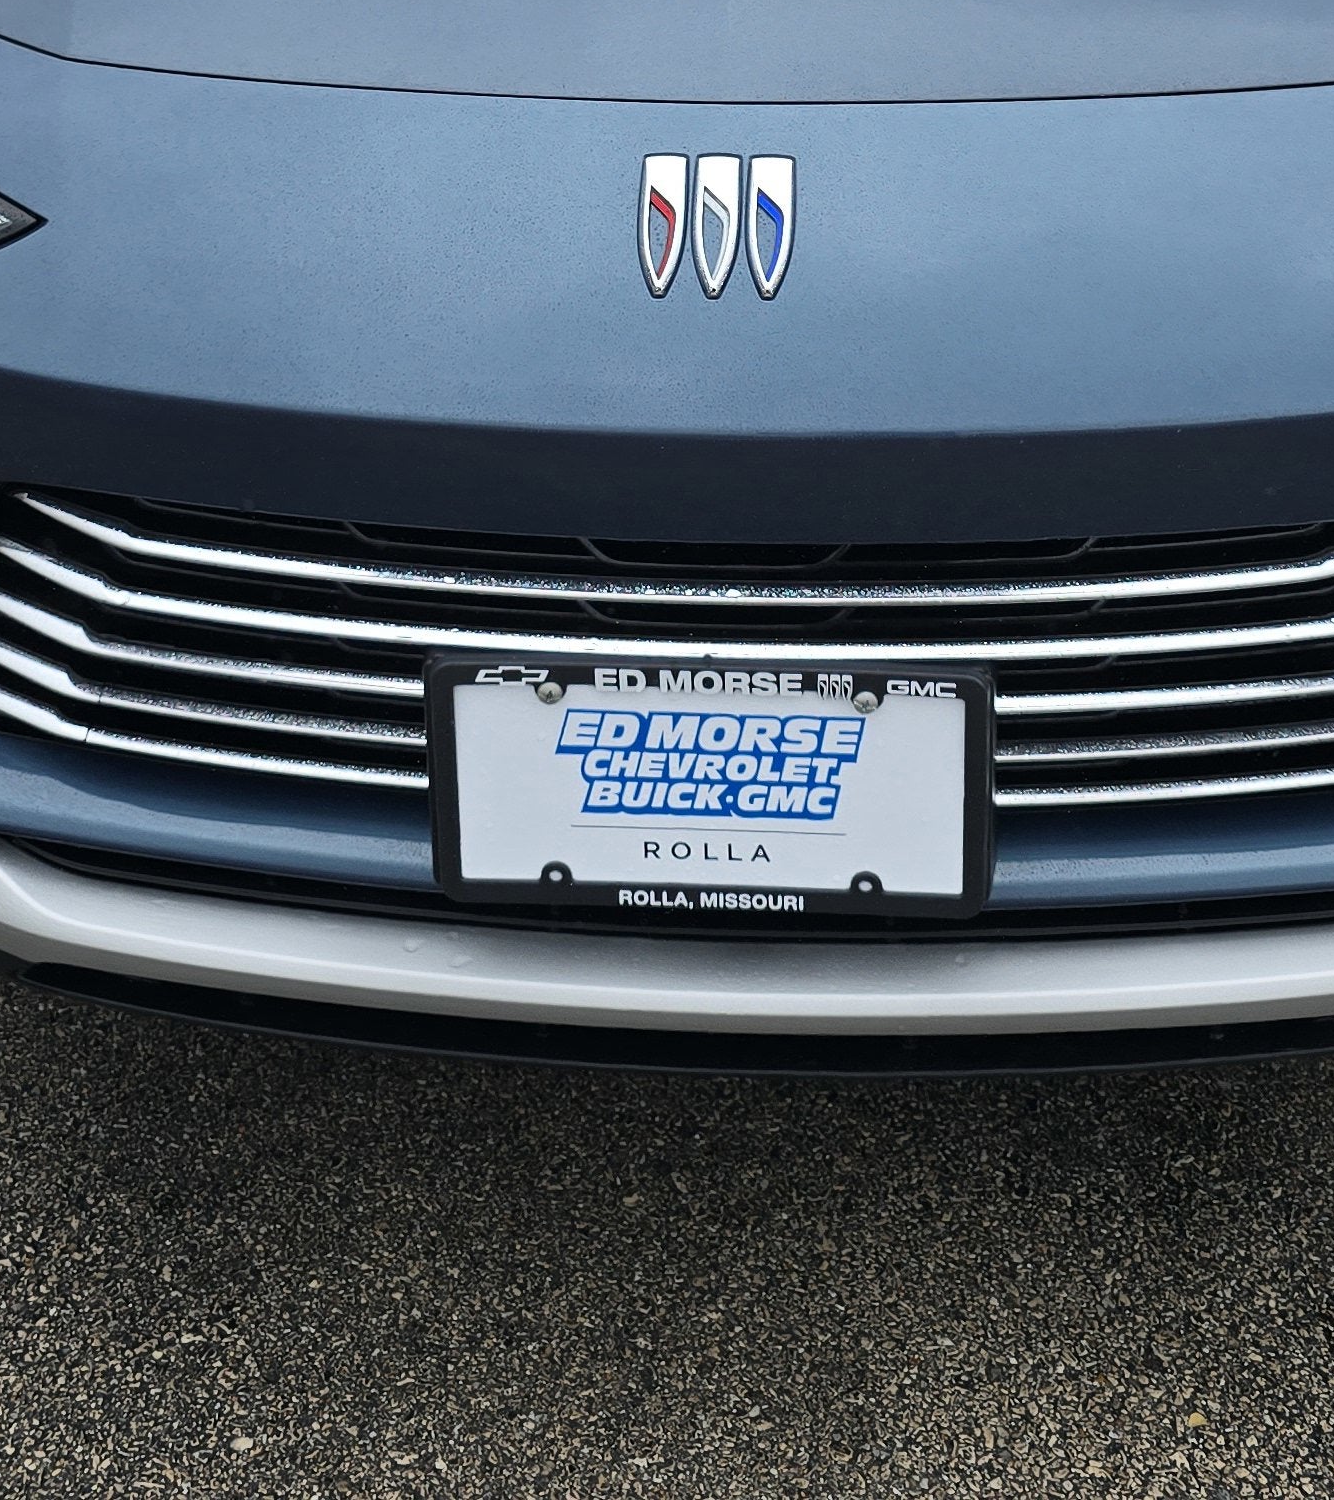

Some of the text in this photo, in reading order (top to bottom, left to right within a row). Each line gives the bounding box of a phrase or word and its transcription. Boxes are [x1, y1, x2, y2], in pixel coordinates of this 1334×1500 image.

[594, 668, 957, 699] ED MORSE GMC
[560, 713, 863, 755] ED MORSE
[584, 750, 838, 784] CHEVROLET
[644, 841, 771, 863] ROLLA
[619, 889, 805, 912] ROLLA, MISSOURI
